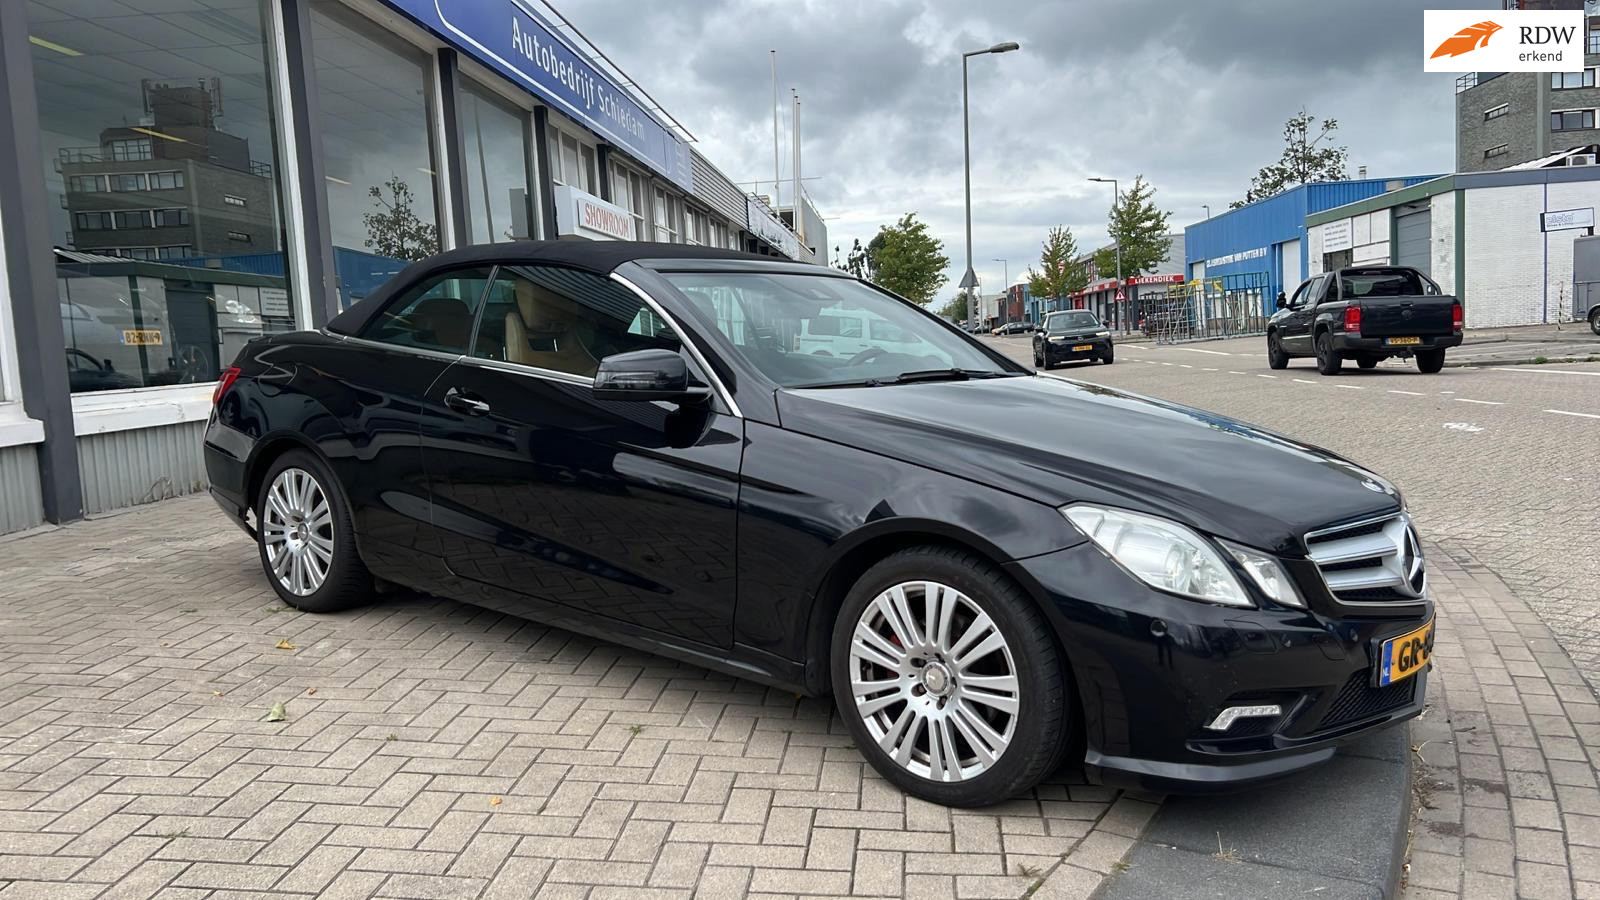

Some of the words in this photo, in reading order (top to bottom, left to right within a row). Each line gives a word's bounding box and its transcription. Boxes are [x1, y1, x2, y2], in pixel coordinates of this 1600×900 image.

[512, 16, 595, 110] Autobedrijf
[597, 84, 646, 141] Schiedam
[584, 202, 630, 239] SHOWROOM
[1134, 274, 1175, 284] LIEKENDIEK
